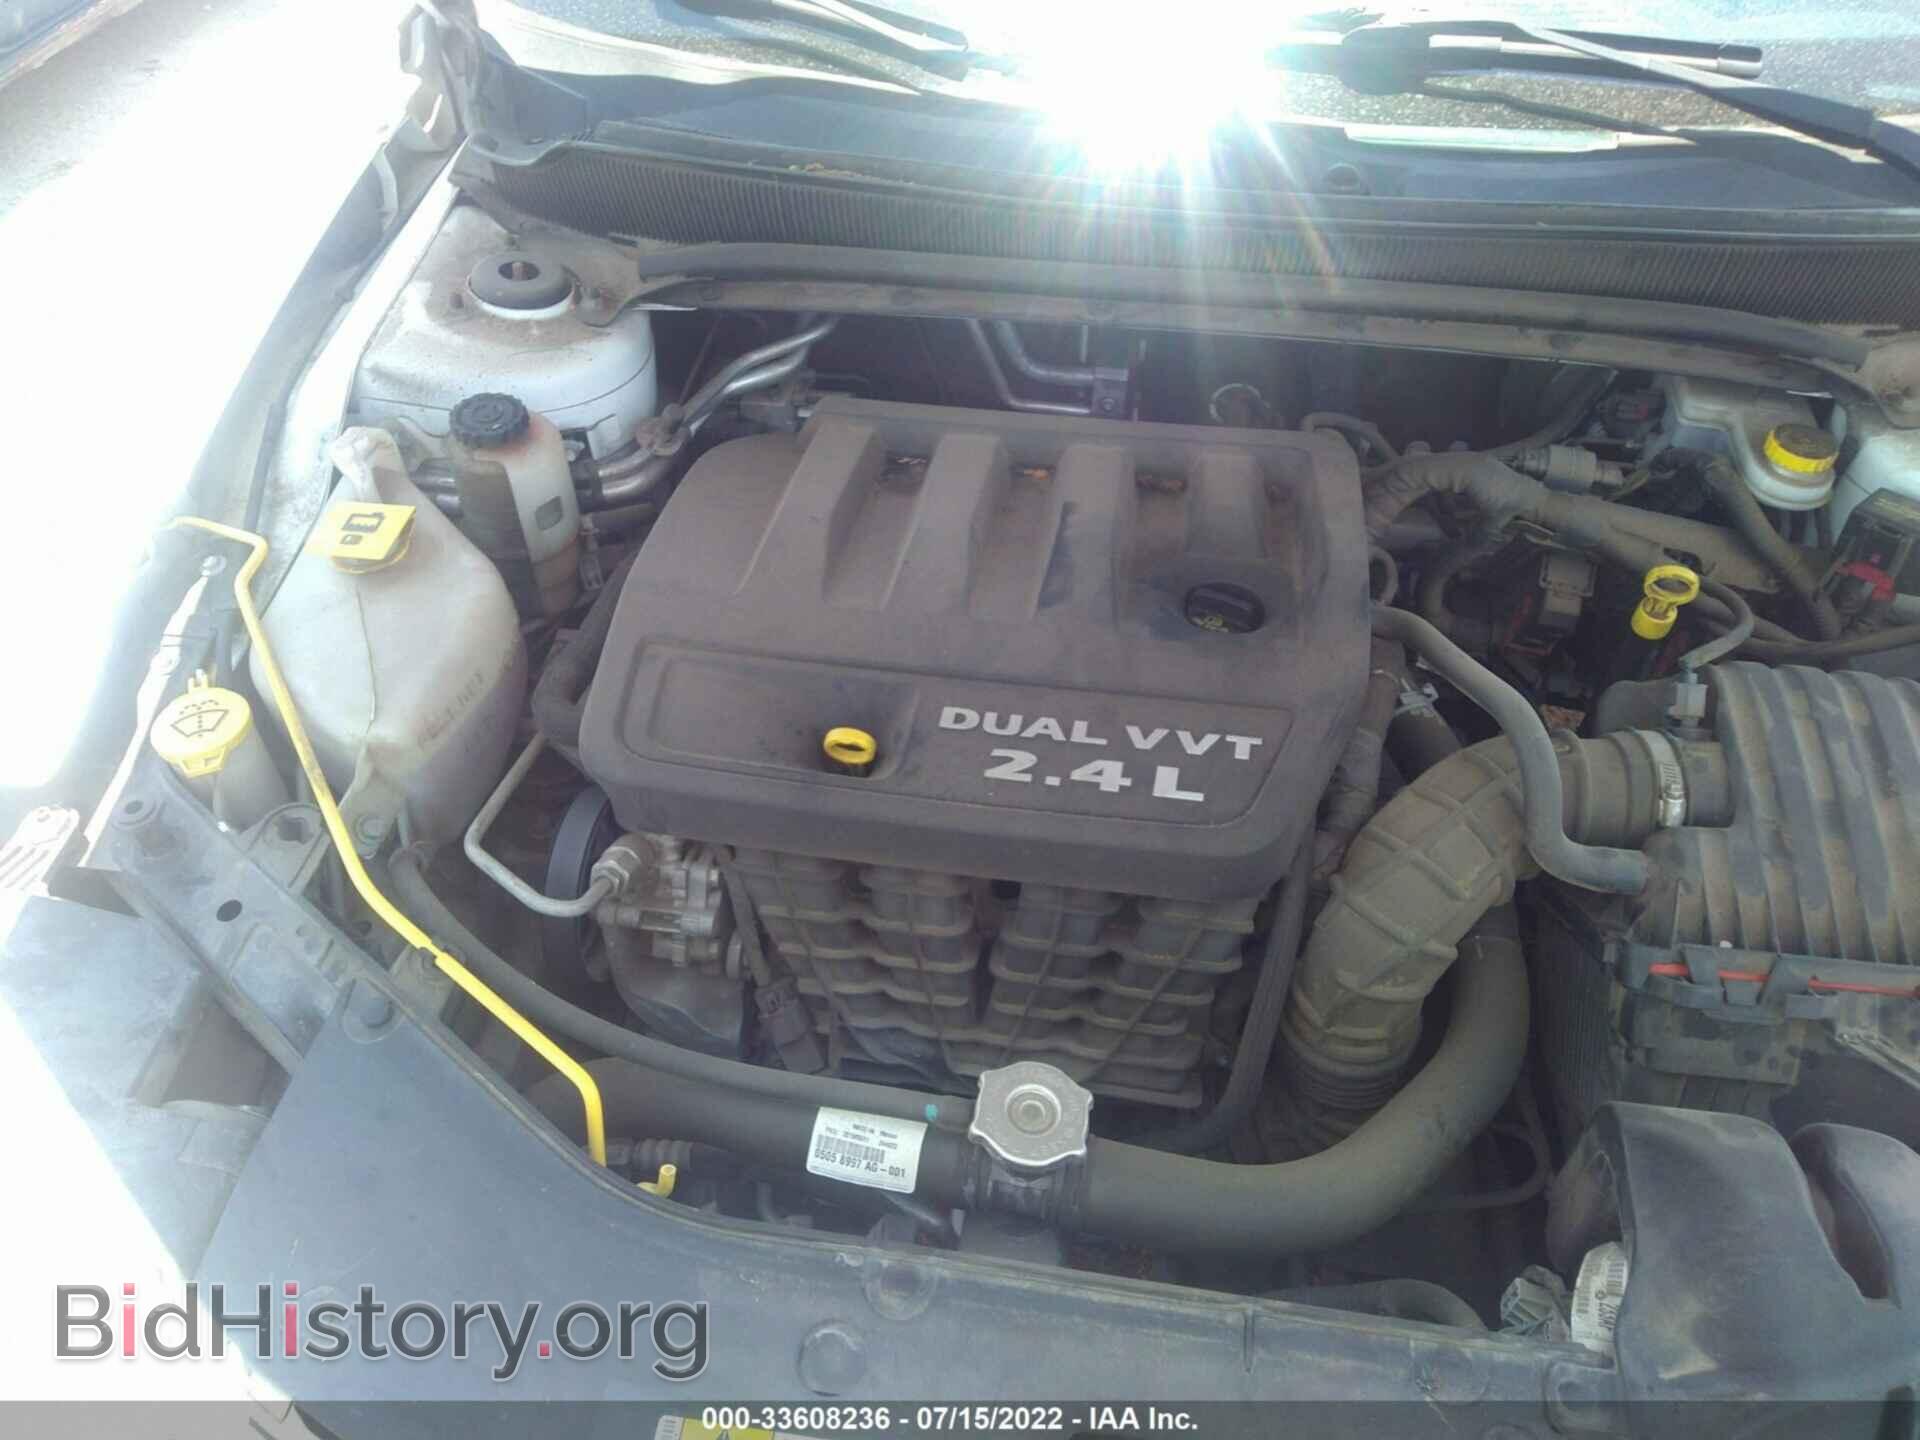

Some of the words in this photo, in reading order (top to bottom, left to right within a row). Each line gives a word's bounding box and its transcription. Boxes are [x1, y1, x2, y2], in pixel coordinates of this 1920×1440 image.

[938, 706, 1108, 745] DUAL
[1125, 725, 1263, 760] VVT
[983, 748, 1132, 792] 2.4
[1152, 766, 1204, 801] L
